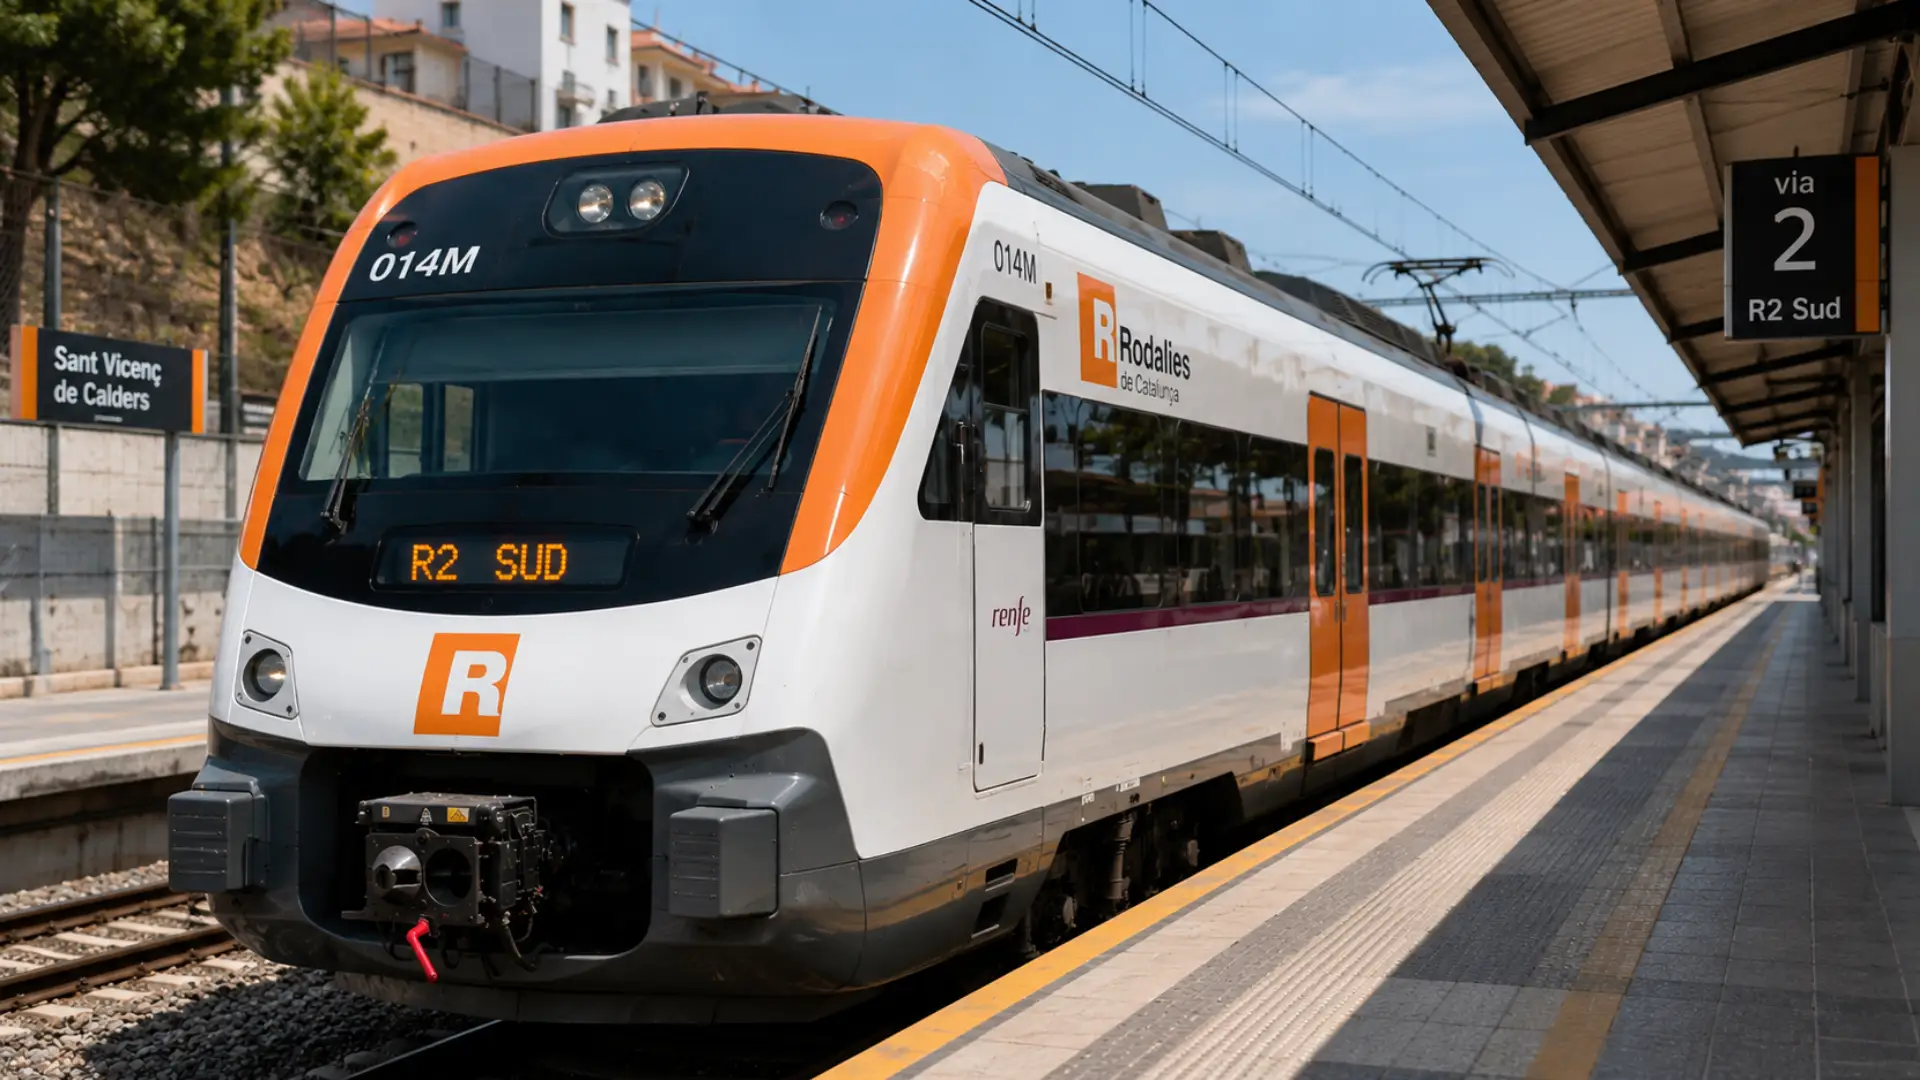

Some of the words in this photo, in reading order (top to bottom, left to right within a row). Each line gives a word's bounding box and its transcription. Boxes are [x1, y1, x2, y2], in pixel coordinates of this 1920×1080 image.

[1774, 170, 1815, 195] via
[1773, 206, 1816, 272] 2
[369, 245, 481, 282] 014M
[993, 239, 1037, 285] 014M
[1093, 297, 1116, 363] R
[1749, 298, 1783, 322] R2
[1792, 296, 1841, 321] Sud
[54, 345, 99, 375] Sant
[102, 351, 163, 388] Vicenç
[1119, 325, 1191, 381] Rodalies
[54, 379, 79, 404] de
[83, 382, 151, 411] Calders
[1120, 370, 1133, 392] de
[411, 543, 459, 582] R2
[495, 543, 568, 582] SUD
[992, 595, 1031, 637] renfe
[441, 649, 508, 717] R
